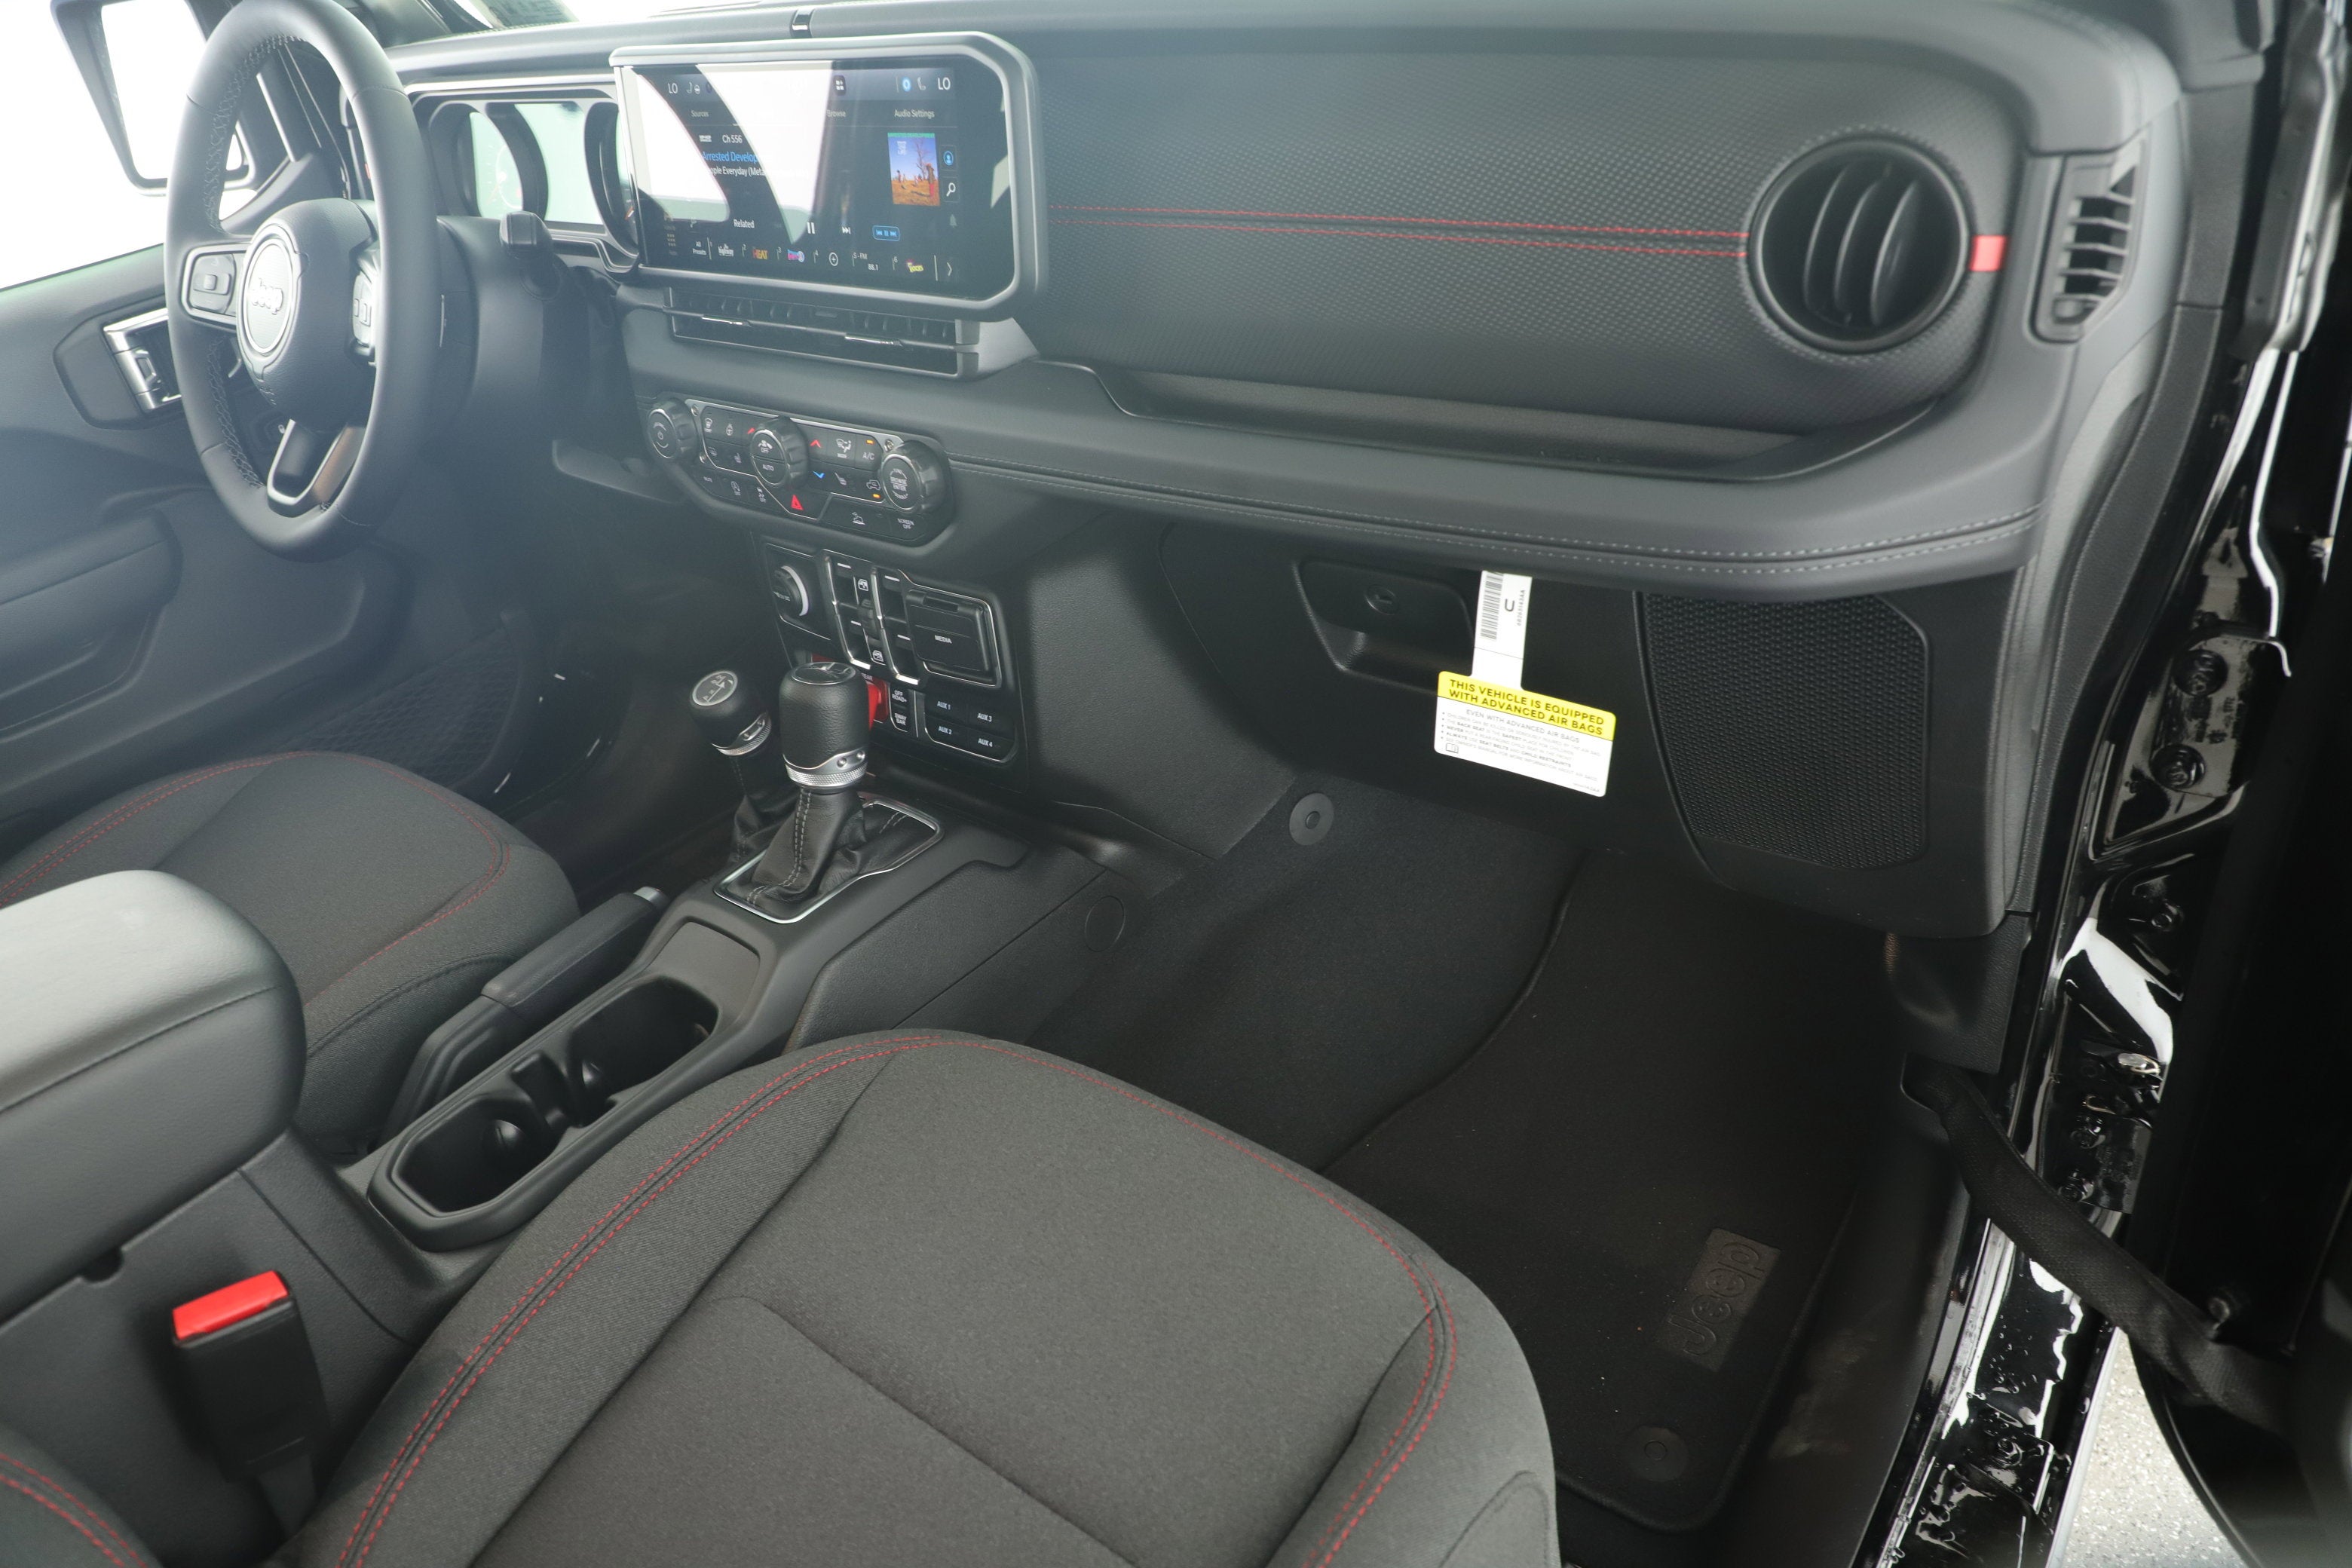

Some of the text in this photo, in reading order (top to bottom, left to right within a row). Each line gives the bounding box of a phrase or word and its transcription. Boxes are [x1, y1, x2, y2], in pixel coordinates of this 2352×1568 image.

[668, 83, 678, 94] LO
[938, 77, 951, 90] LO
[894, 109, 935, 119] Audio Settings
[722, 135, 743, 143] Ch 556
[703, 152, 758, 164] Arrested Develop
[723, 167, 747, 177] Everyday
[733, 219, 755, 228] Related
[752, 249, 768, 260] HEAT
[862, 452, 874, 461] A/C
[897, 518, 914, 526] SCREEN
[1505, 599, 1515, 611] U
[935, 635, 953, 645] MEDIA
[936, 700, 947, 709] AUX
[1450, 679, 1605, 725] THIS VEHICLE IS EQUIPPED
[977, 712, 988, 721] AUX
[1449, 689, 1603, 736] WITH ADVANCED AIR BAGS
[938, 725, 948, 733] AUX
[1466, 709, 1484, 718] EVEN
[1487, 714, 1505, 722] WITH
[1506, 720, 1545, 734] ADVANCED
[1560, 733, 1580, 743] BAGS
[978, 737, 988, 746] AUX
